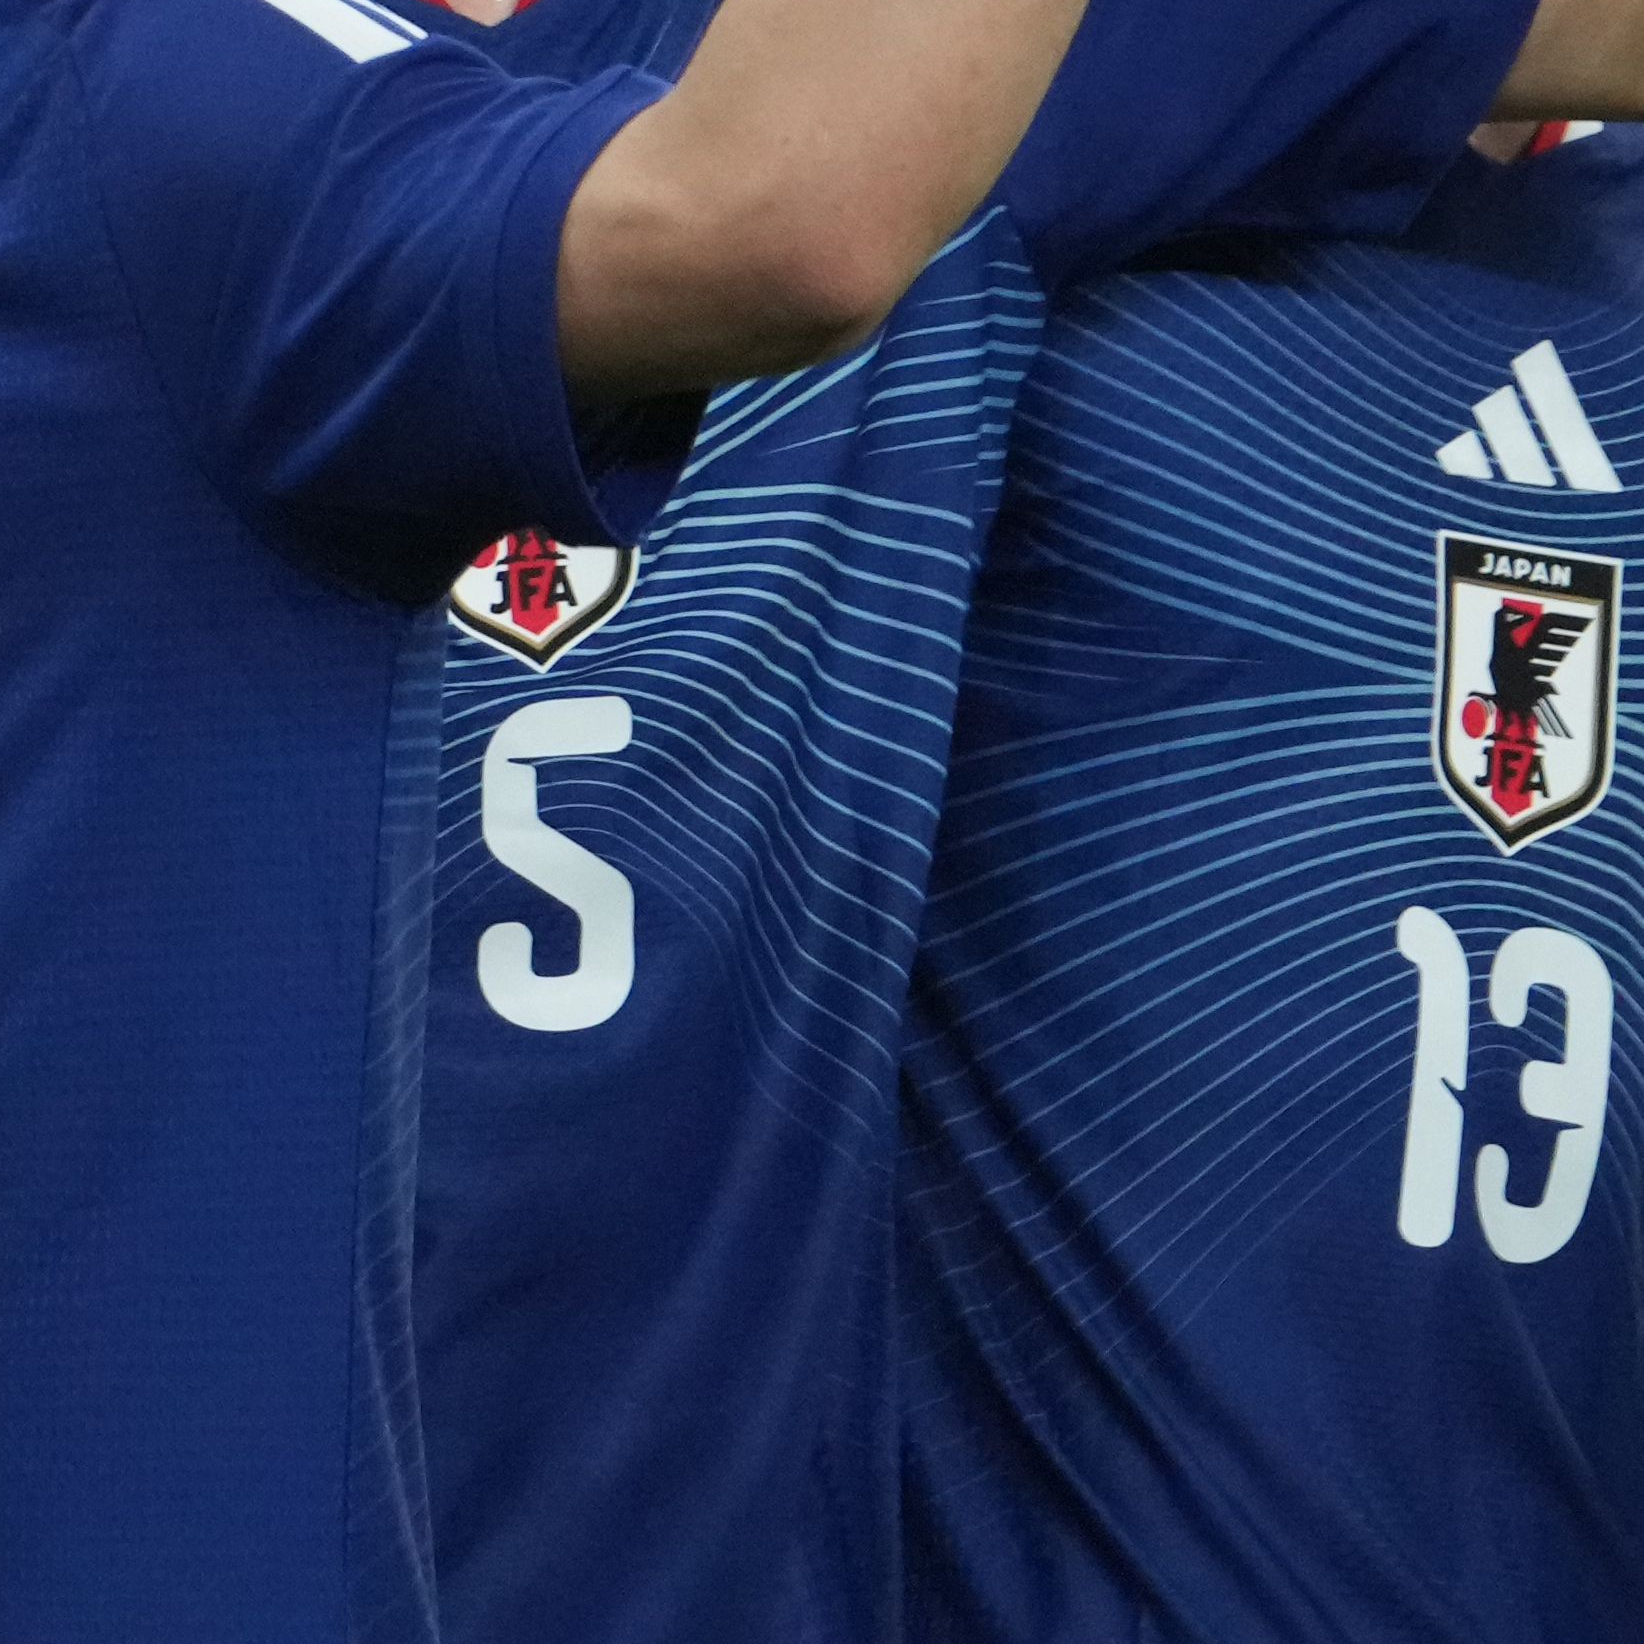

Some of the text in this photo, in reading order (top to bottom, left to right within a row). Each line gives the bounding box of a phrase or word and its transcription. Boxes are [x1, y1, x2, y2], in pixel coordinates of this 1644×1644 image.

[490, 565, 578, 614] JFA
[1477, 552, 1572, 587] JAPAN
[1474, 745, 1551, 798] JFA
[477, 695, 635, 1032] 5
[1396, 905, 1614, 1264] 13
